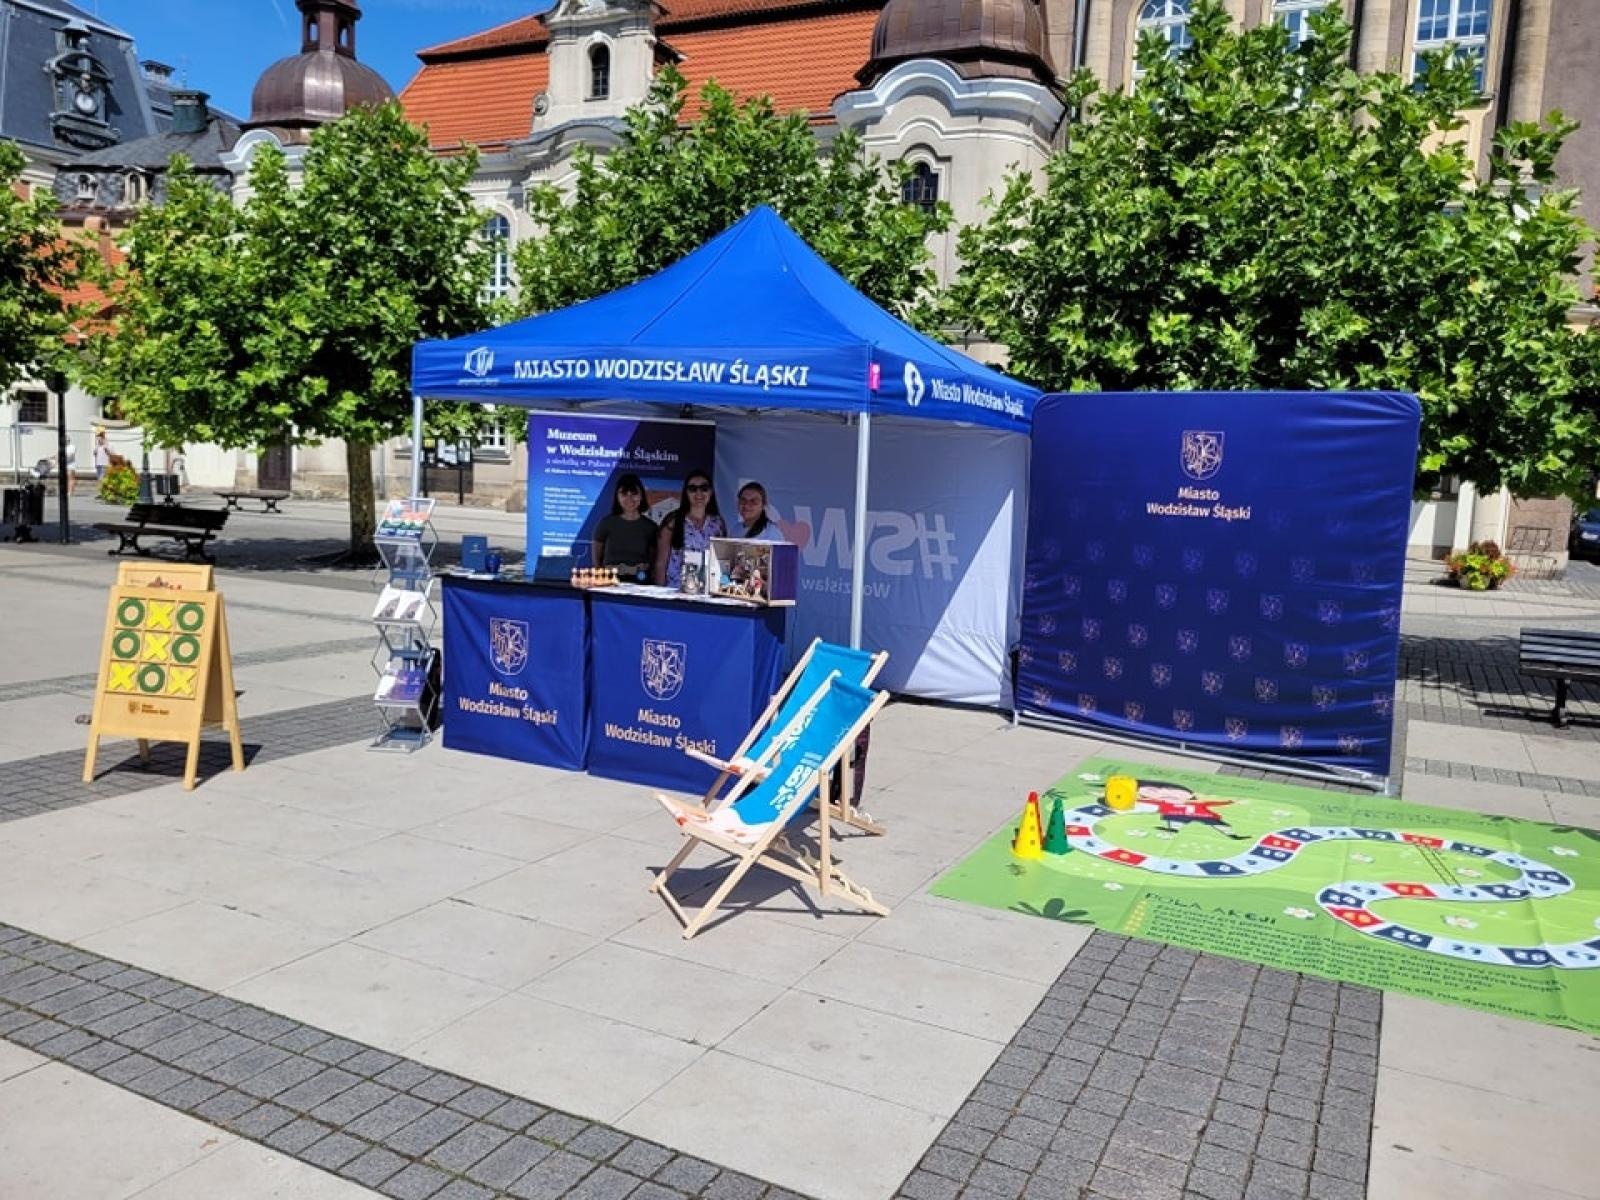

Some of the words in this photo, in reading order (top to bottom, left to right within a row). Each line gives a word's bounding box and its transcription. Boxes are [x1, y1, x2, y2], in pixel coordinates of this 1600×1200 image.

[513, 359, 590, 379] MIASTO
[594, 359, 725, 384] WODZISŁAW
[729, 358, 810, 391] ŚLĄSKI
[931, 378, 961, 403] Miasto
[962, 384, 1004, 412] Wodzisław
[546, 427, 597, 443] Muzeum
[546, 446, 557, 454] w
[633, 445, 679, 463] Śląskim
[1177, 486, 1220, 501] Miasto
[1146, 502, 1211, 518] Wodzisław
[1212, 503, 1251, 523] Śląski
[489, 681, 528, 701] Miasto
[459, 696, 521, 718] Wodzisław
[522, 704, 558, 726] Śląski
[638, 707, 681, 729] Miasto
[605, 722, 673, 748] Wodzisław
